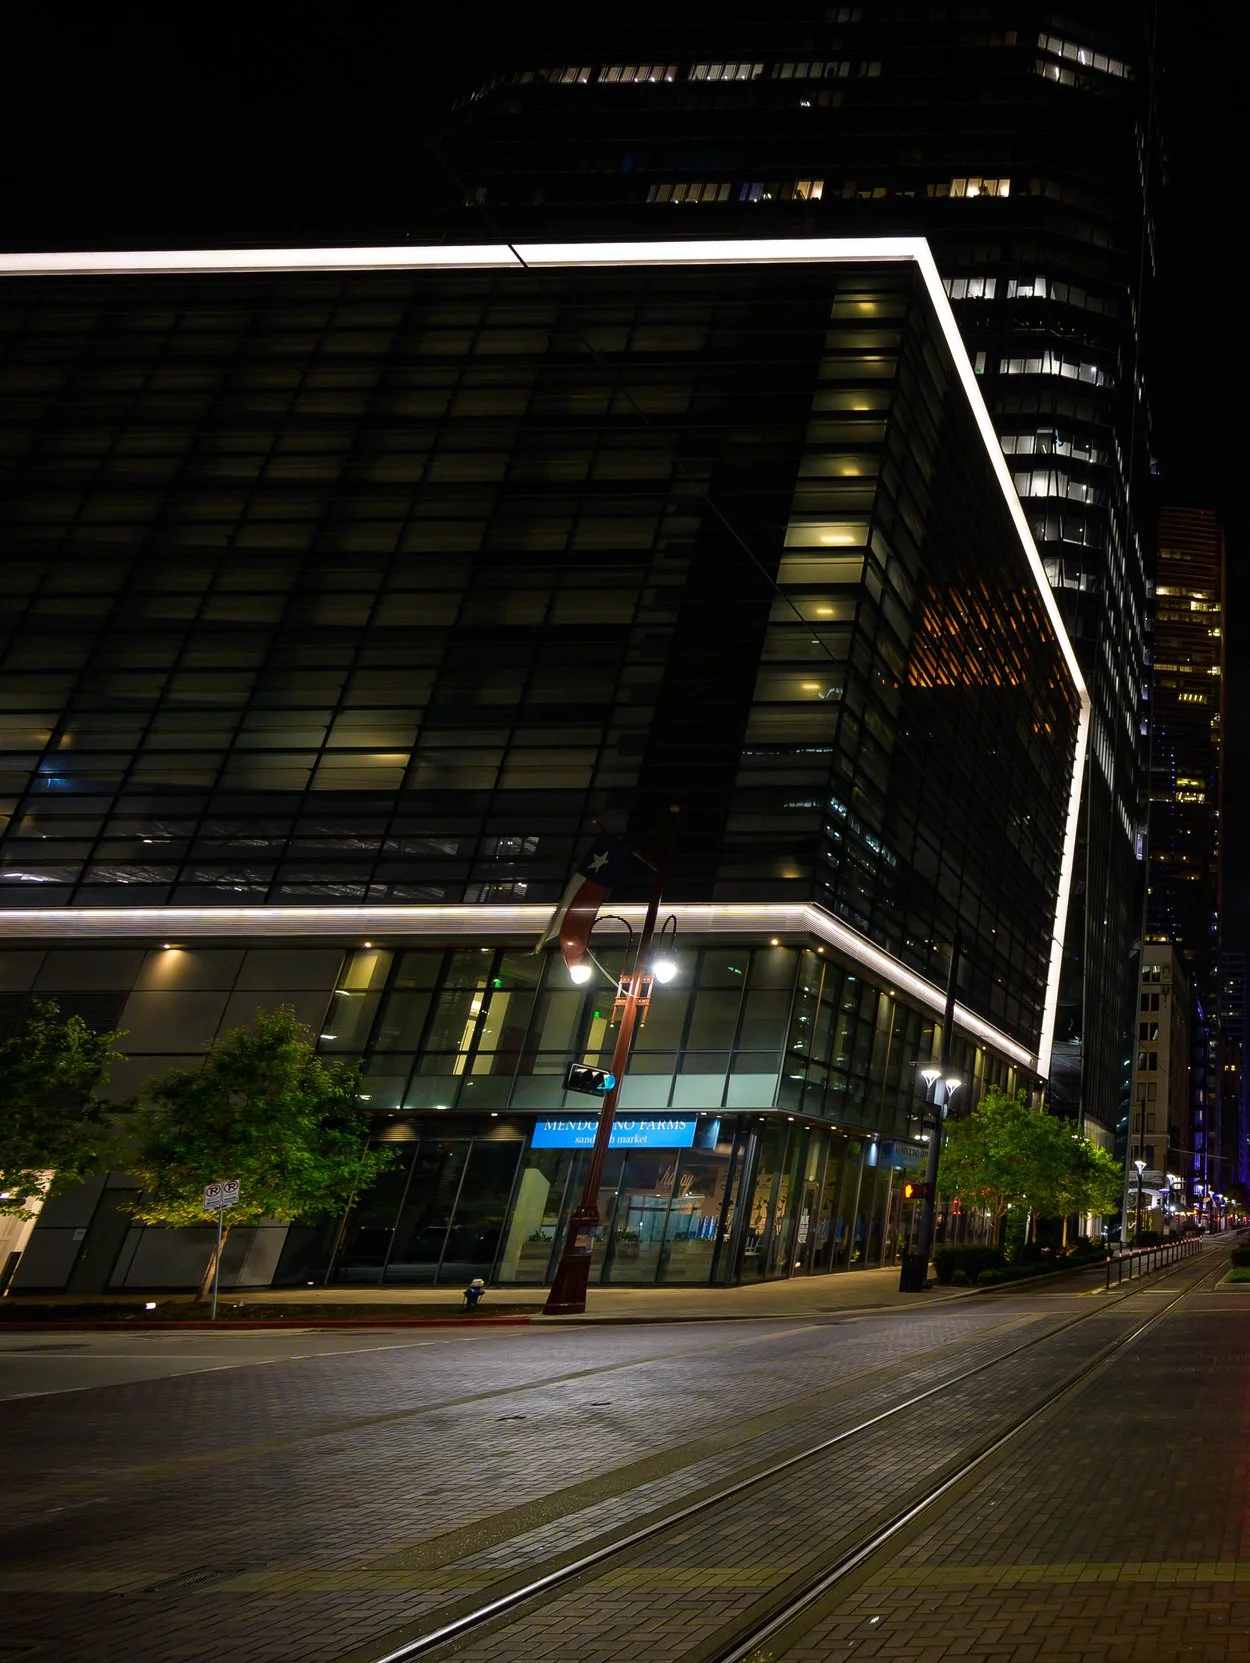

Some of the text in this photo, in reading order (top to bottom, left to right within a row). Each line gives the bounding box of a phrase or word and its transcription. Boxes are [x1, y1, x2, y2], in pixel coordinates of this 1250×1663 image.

[544, 1119, 686, 1131] MENDONO FARMS
[575, 1134, 647, 1144] sandh market
